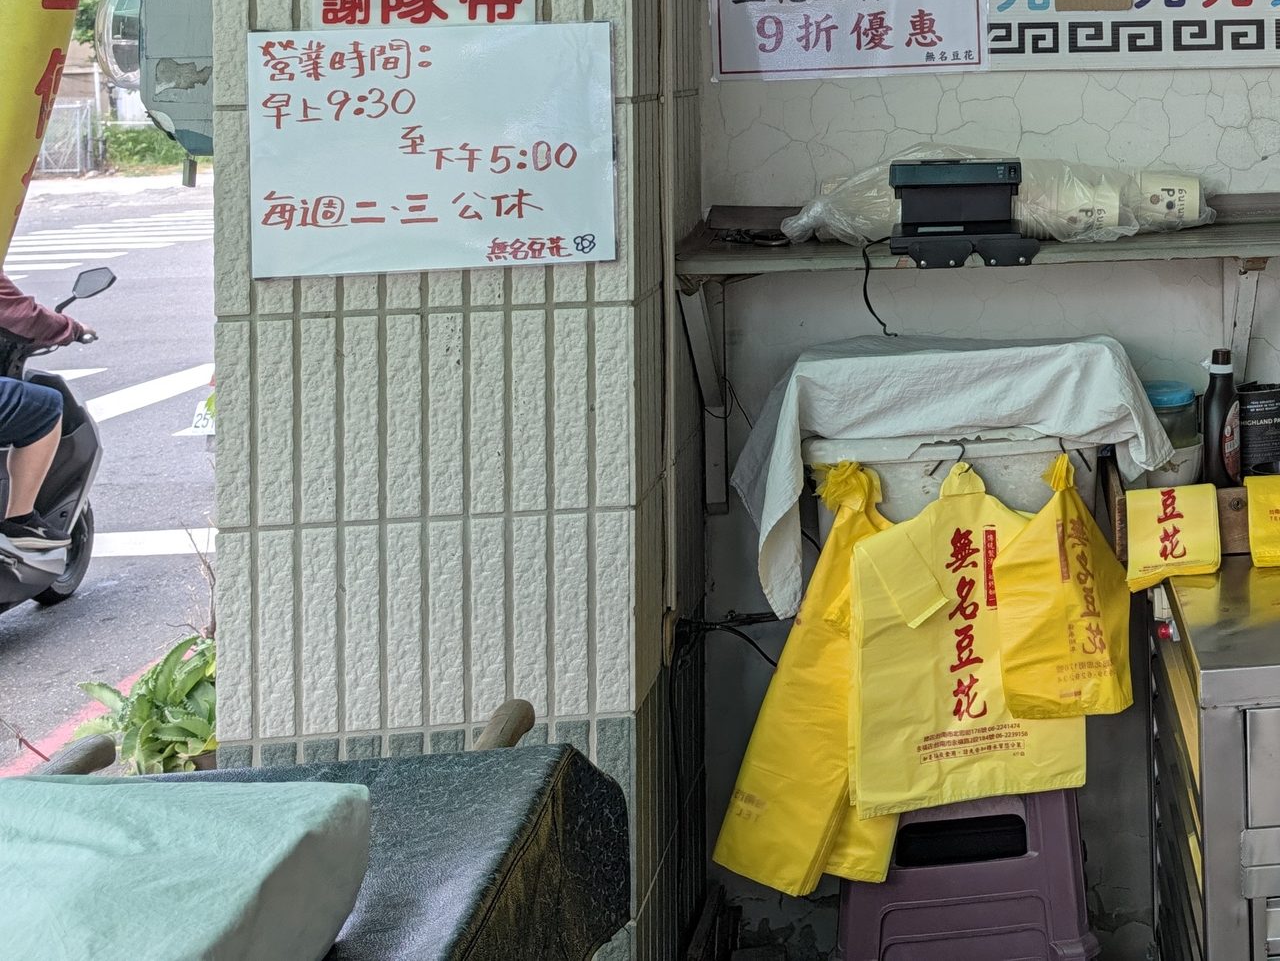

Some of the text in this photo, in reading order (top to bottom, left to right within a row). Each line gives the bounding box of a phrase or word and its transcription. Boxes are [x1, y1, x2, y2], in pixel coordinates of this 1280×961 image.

[755, 9, 944, 54] 9折優惠
[925, 50, 975, 63] 無名豆花
[261, 88, 416, 129] 早上9:30
[398, 125, 426, 155] 至
[486, 236, 573, 262] 無名豆花
[1157, 488, 1187, 561] 豆花
[945, 527, 988, 721] 無名豆花
